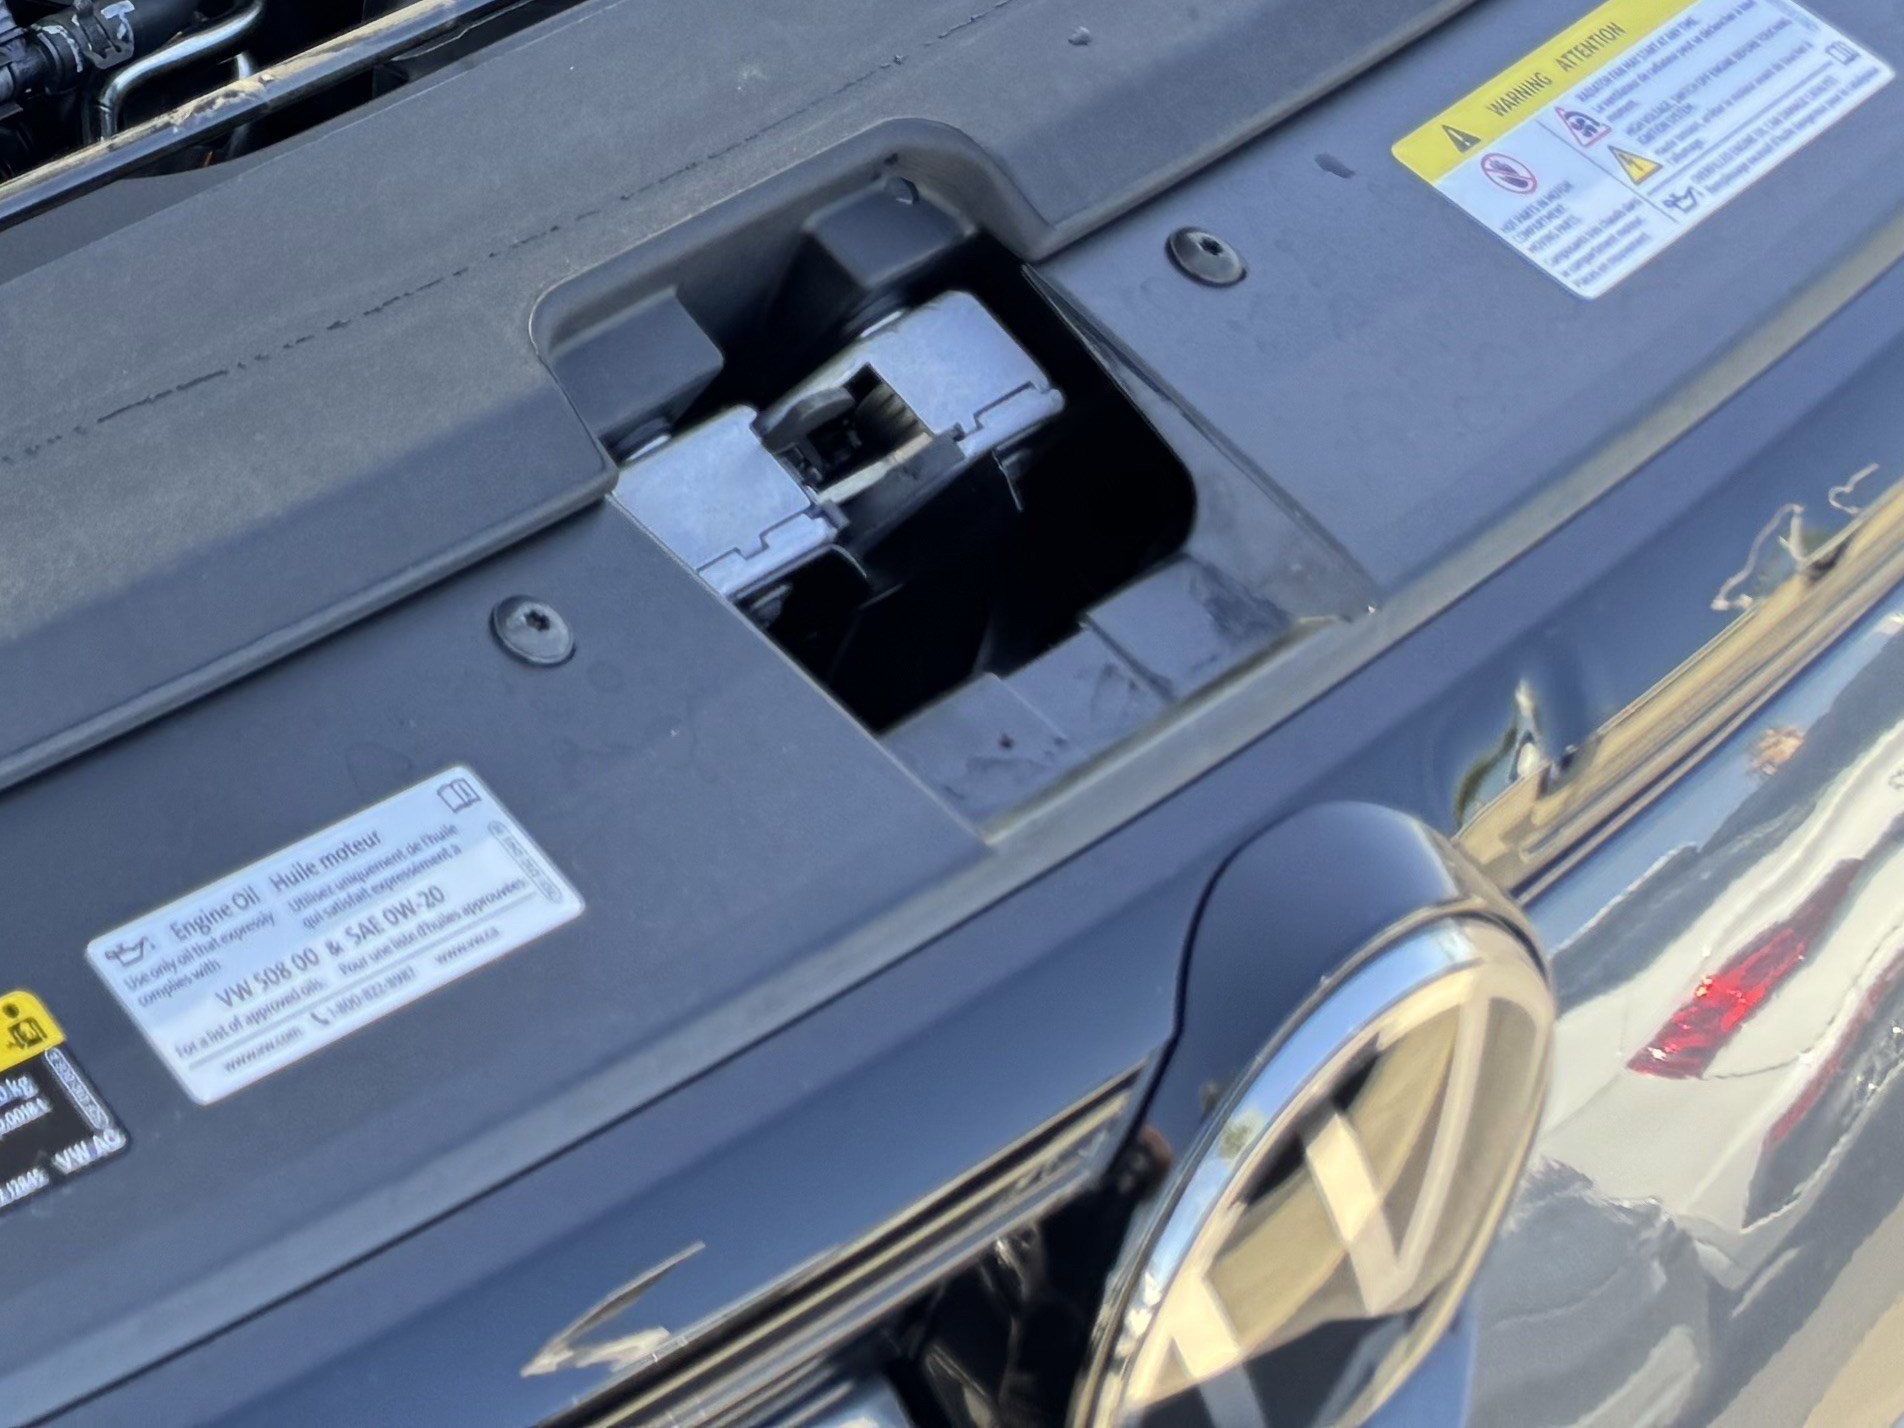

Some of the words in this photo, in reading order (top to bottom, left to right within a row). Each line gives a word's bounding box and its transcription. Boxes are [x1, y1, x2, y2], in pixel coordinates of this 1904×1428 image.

[1485, 70, 1553, 119] WARNING
[1554, 19, 1628, 71] ATTENTION
[267, 857, 319, 892] Huile
[317, 827, 383, 869] moteur
[168, 899, 235, 944] Engine
[230, 885, 262, 911] Oil
[148, 958, 180, 982] only
[190, 936, 222, 958] that
[190, 959, 222, 980] with
[214, 979, 254, 1009] VW
[253, 960, 294, 990] 508
[290, 946, 321, 972] 00
[324, 937, 344, 955] &
[344, 915, 384, 945] SAE
[380, 884, 447, 927] 0W-20
[51, 1141, 96, 1174] VW
